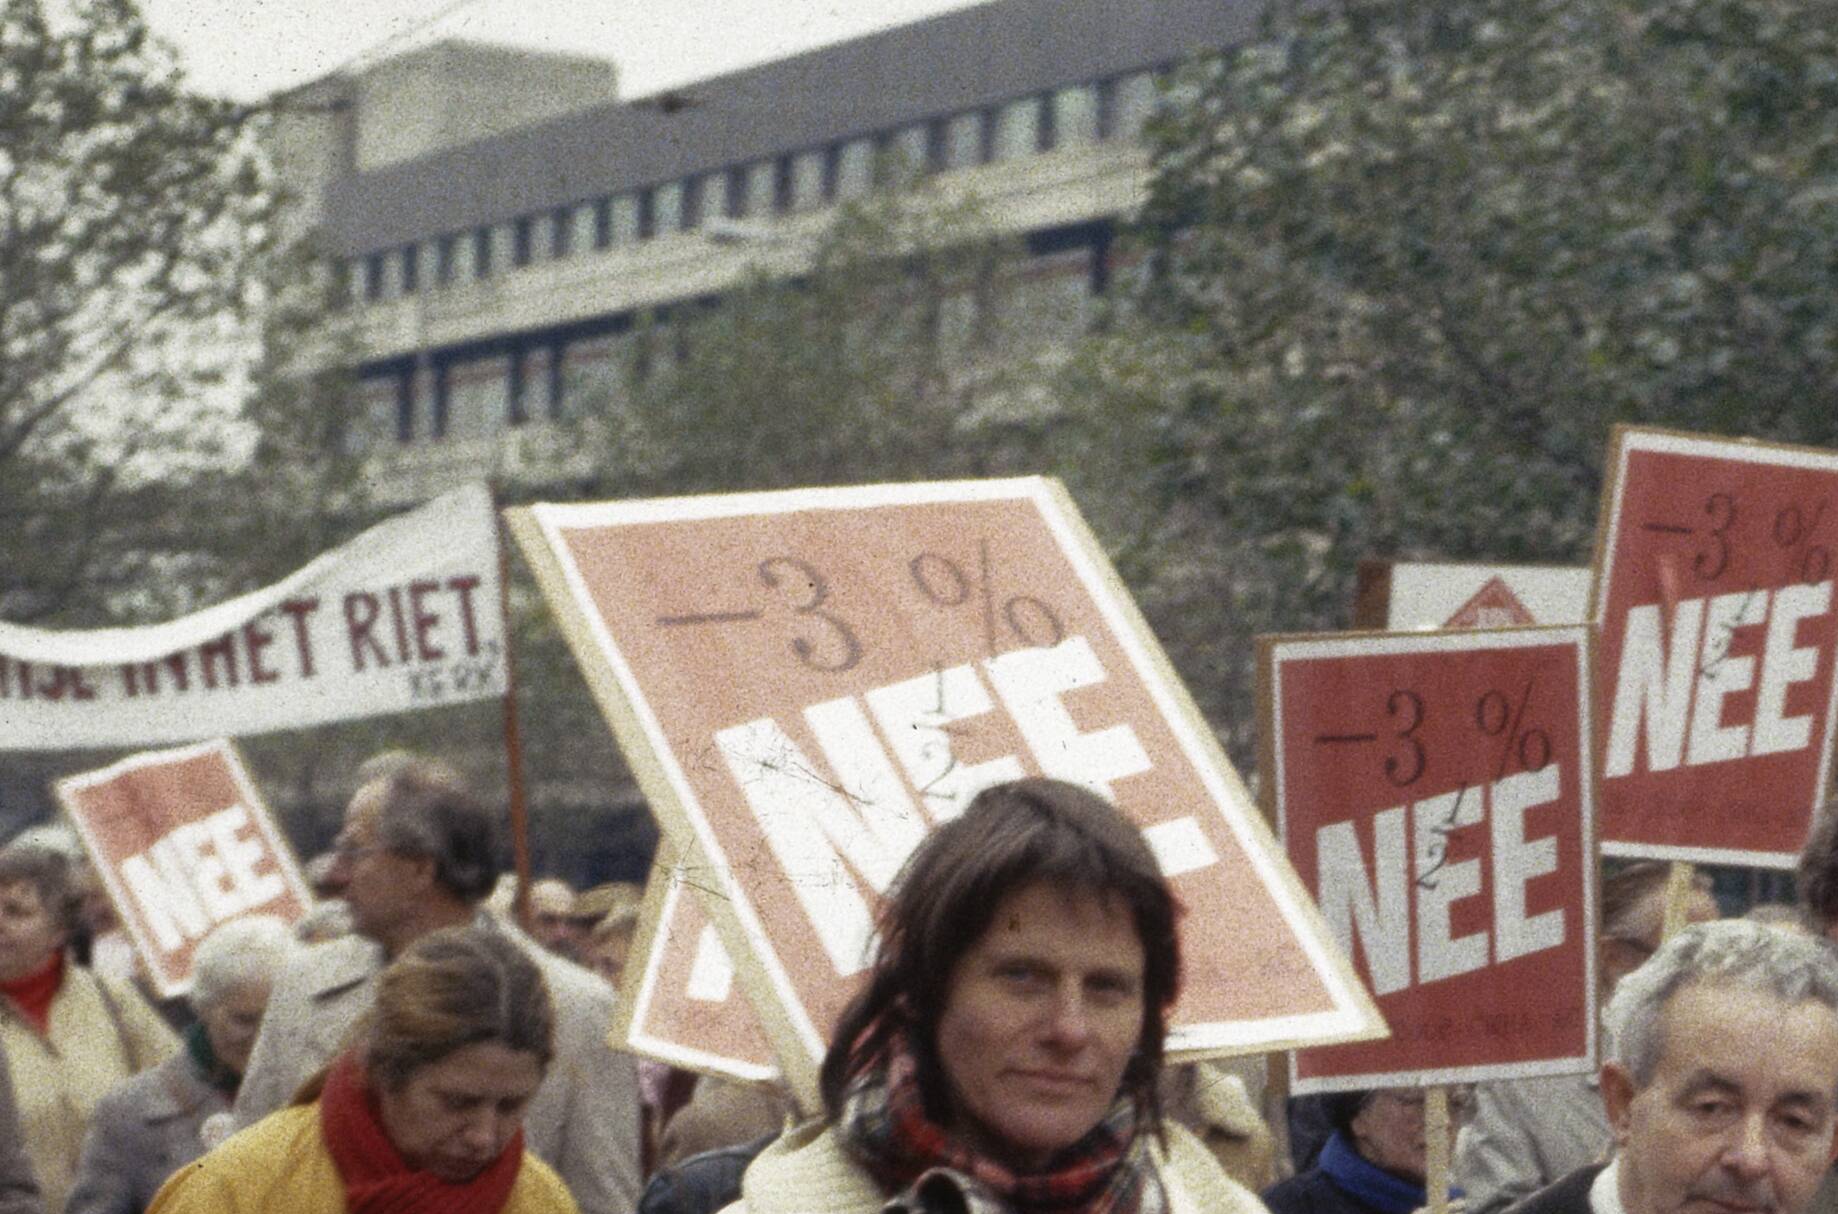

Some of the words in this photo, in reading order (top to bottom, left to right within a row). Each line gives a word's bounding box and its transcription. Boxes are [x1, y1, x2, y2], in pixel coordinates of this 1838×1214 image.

[200, 594, 322, 690] HET
[1604, 578, 1834, 779] NEE
[119, 804, 291, 953] NEE
[713, 634, 1222, 977] NEE
[1314, 762, 1566, 997] NEE
